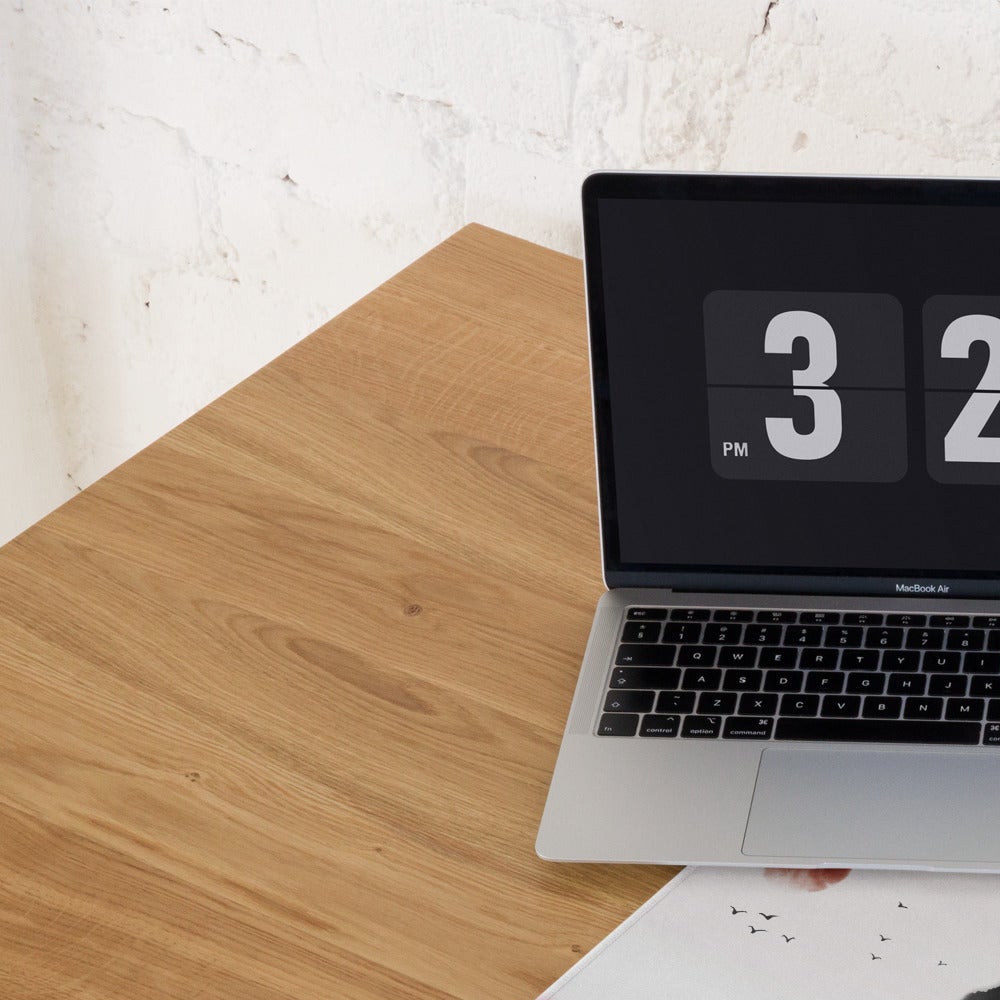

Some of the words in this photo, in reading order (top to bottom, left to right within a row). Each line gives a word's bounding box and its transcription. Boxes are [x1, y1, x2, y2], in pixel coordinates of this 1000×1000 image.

[764, 310, 842, 461] 3
[722, 441, 749, 457] PM
[895, 584, 936, 593] MacBook
[937, 584, 949, 593] Air
[692, 652, 702, 660] Q
[779, 677, 788, 685] D
[861, 679, 870, 687] G
[713, 699, 721, 707] Z
[795, 701, 804, 709] C
[837, 702, 846, 710] V
[878, 703, 886, 711] B
[919, 704, 928, 712] N
